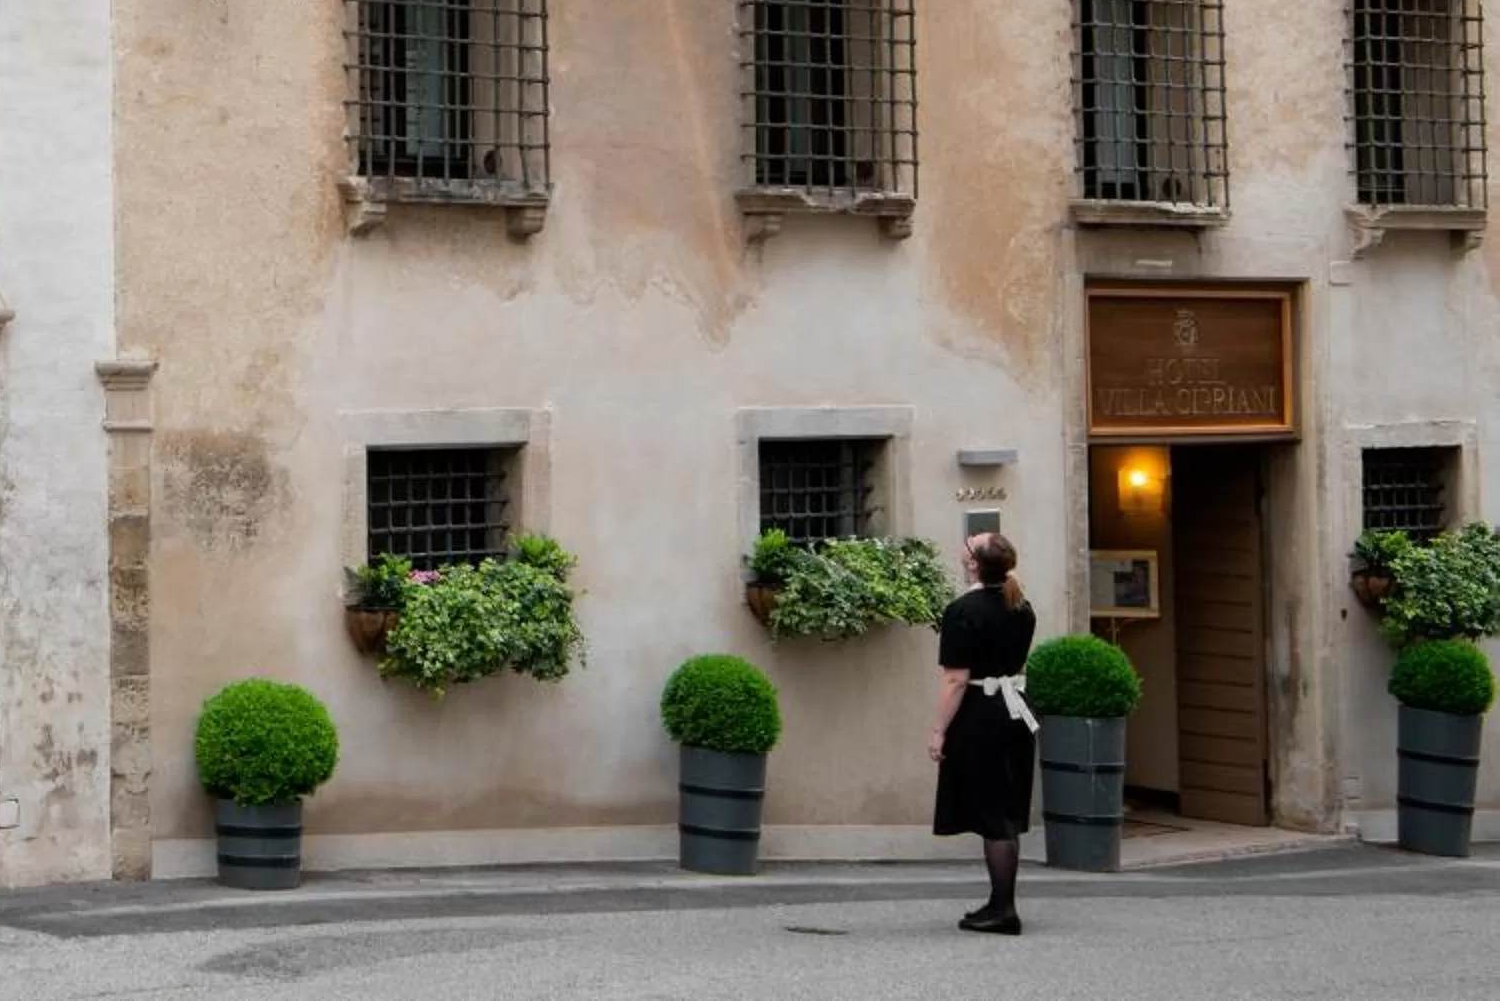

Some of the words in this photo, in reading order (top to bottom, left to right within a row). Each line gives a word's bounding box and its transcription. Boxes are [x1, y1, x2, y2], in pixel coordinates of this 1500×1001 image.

[1146, 358, 1227, 386] HOTEL
[1098, 387, 1172, 416] VILLA
[1176, 386, 1277, 415] CIPRIANI
